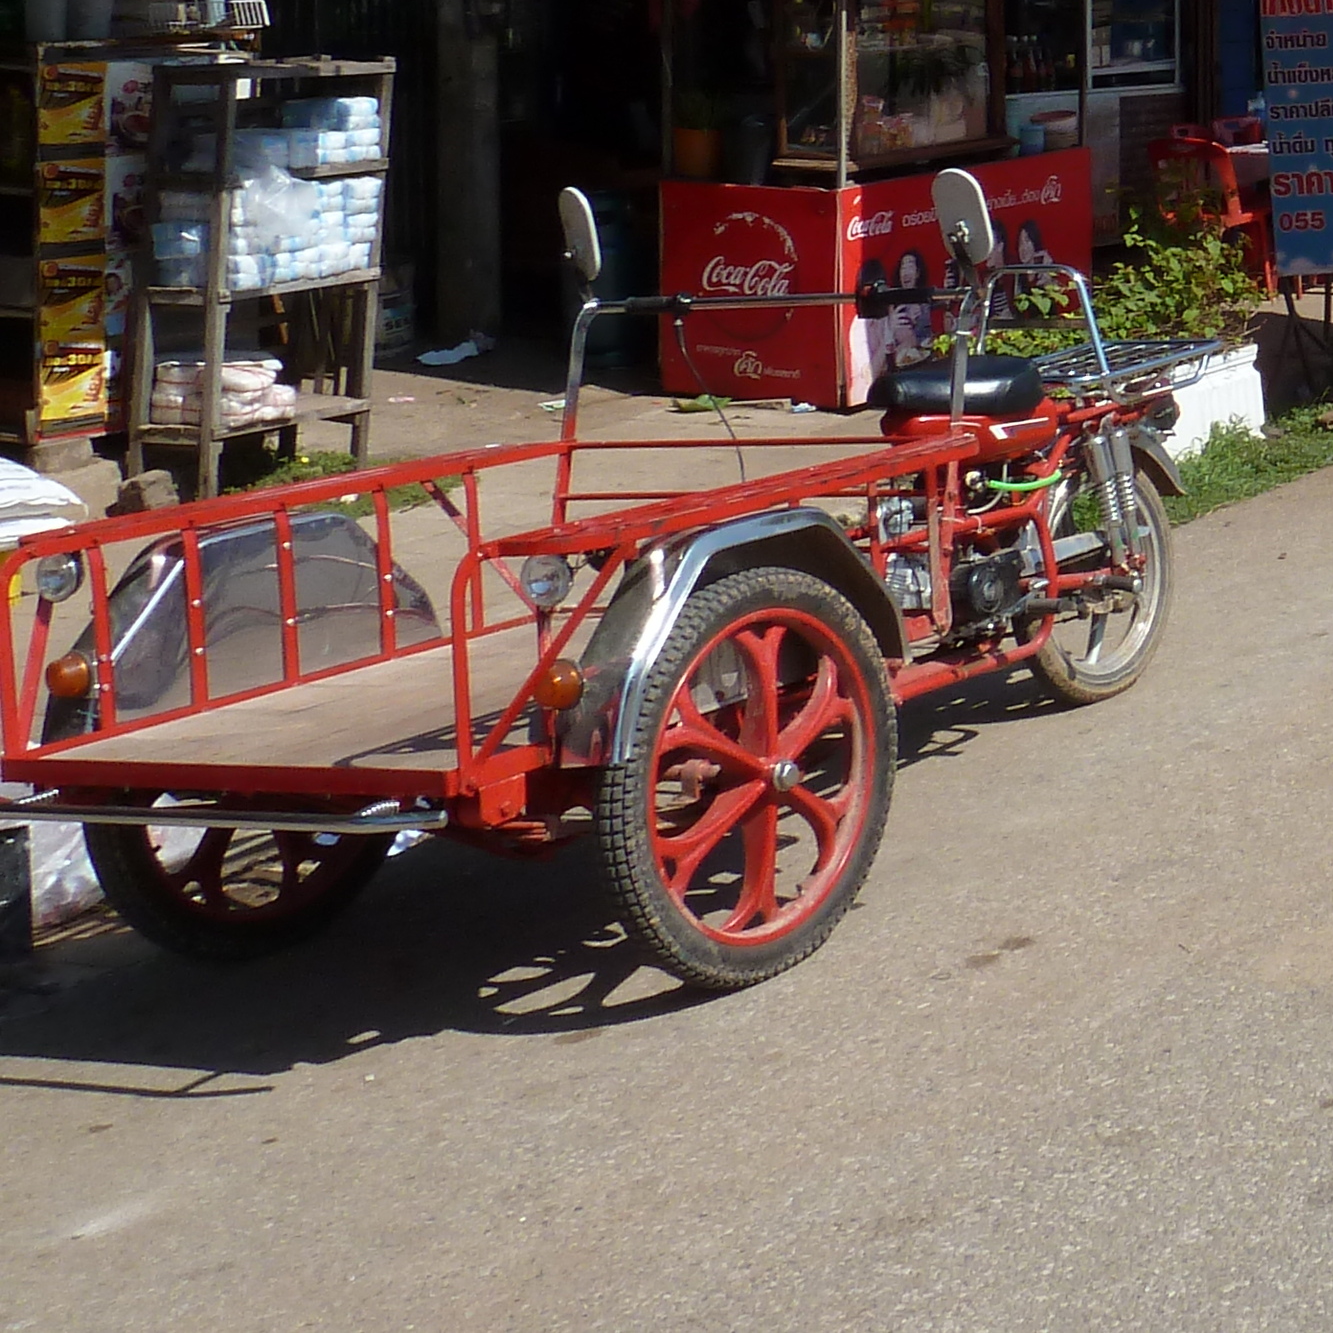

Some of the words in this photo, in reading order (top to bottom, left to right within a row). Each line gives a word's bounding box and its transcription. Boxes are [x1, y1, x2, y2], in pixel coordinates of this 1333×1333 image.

[1265, 29, 1328, 50] จำหน่าย
[1271, 130, 1316, 156] น้ำดื่ม
[846, 210, 895, 241] Coca-Cola
[1278, 211, 1326, 233] 055
[702, 256, 795, 296] Coca-Cola
